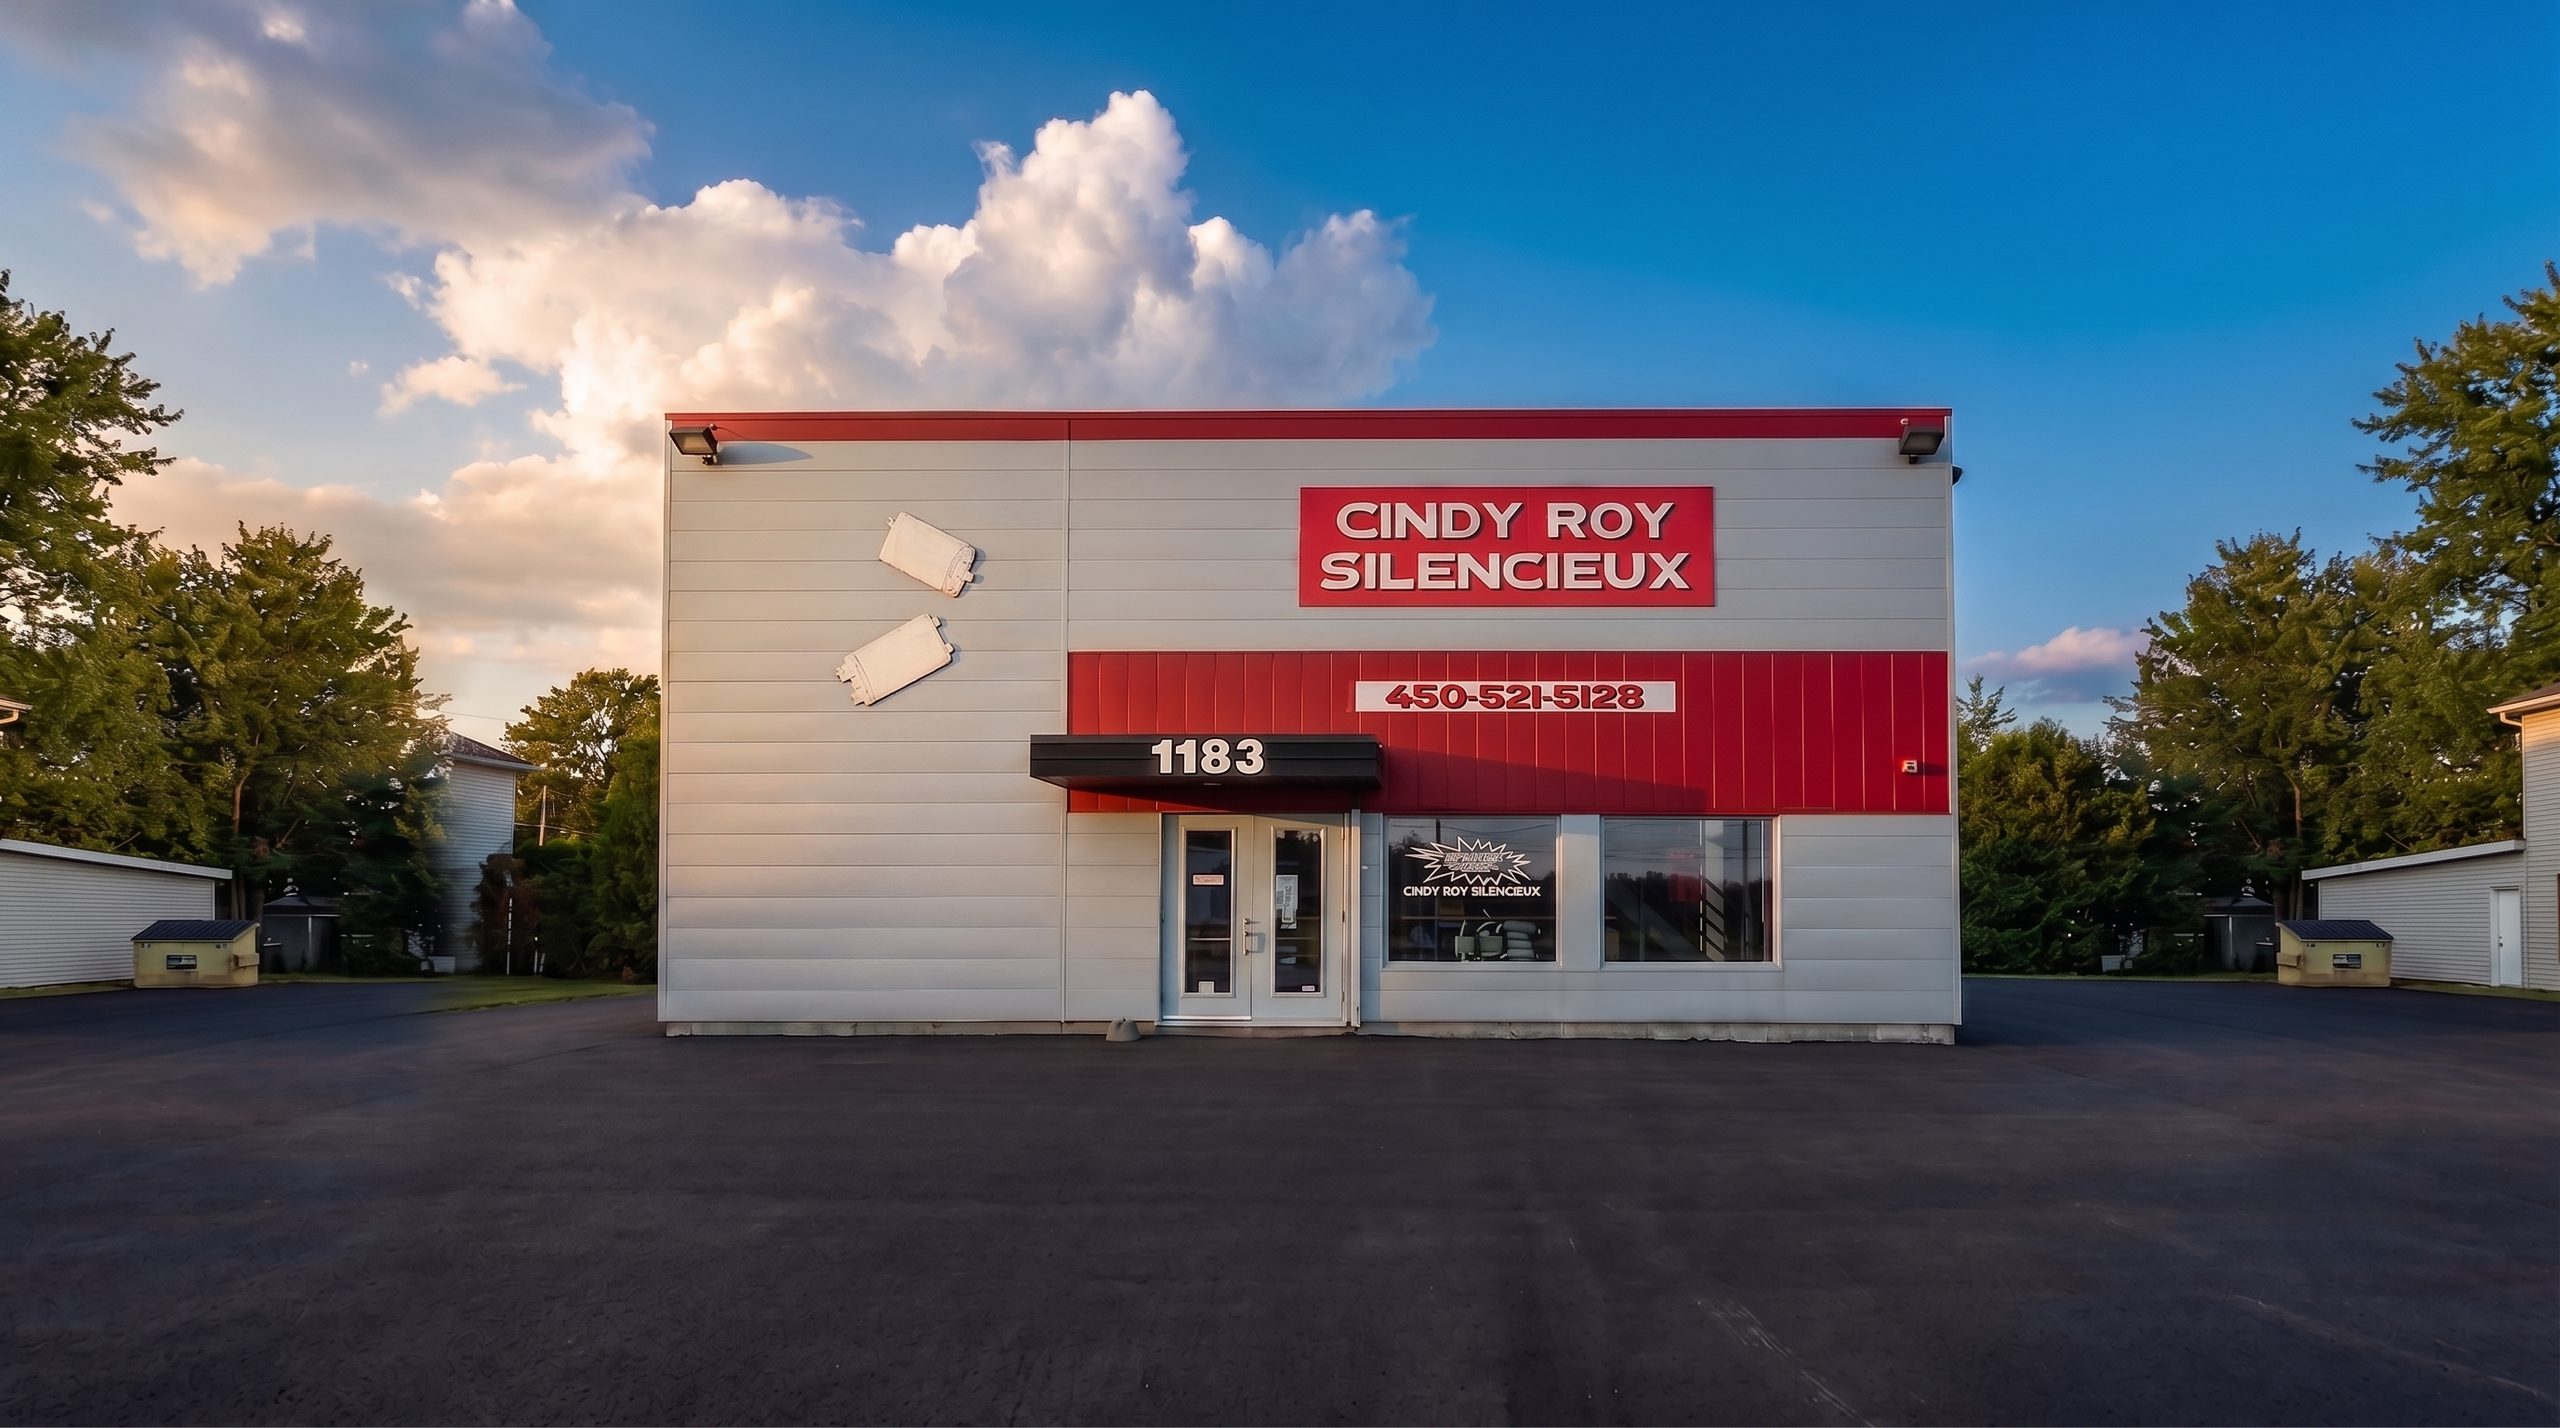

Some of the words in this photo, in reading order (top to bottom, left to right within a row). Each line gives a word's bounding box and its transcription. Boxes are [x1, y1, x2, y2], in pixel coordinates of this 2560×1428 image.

[1336, 502, 1524, 539] CINDY
[1546, 502, 1675, 539] ROY
[1320, 552, 1690, 590] SILENCIEUX
[1385, 684, 1645, 709] 450-521-5128
[1151, 738, 1265, 774] 1183
[1403, 886, 1440, 897] CINDY
[1442, 886, 1469, 897] ROY
[1471, 886, 1541, 897] SILENCIEUX
